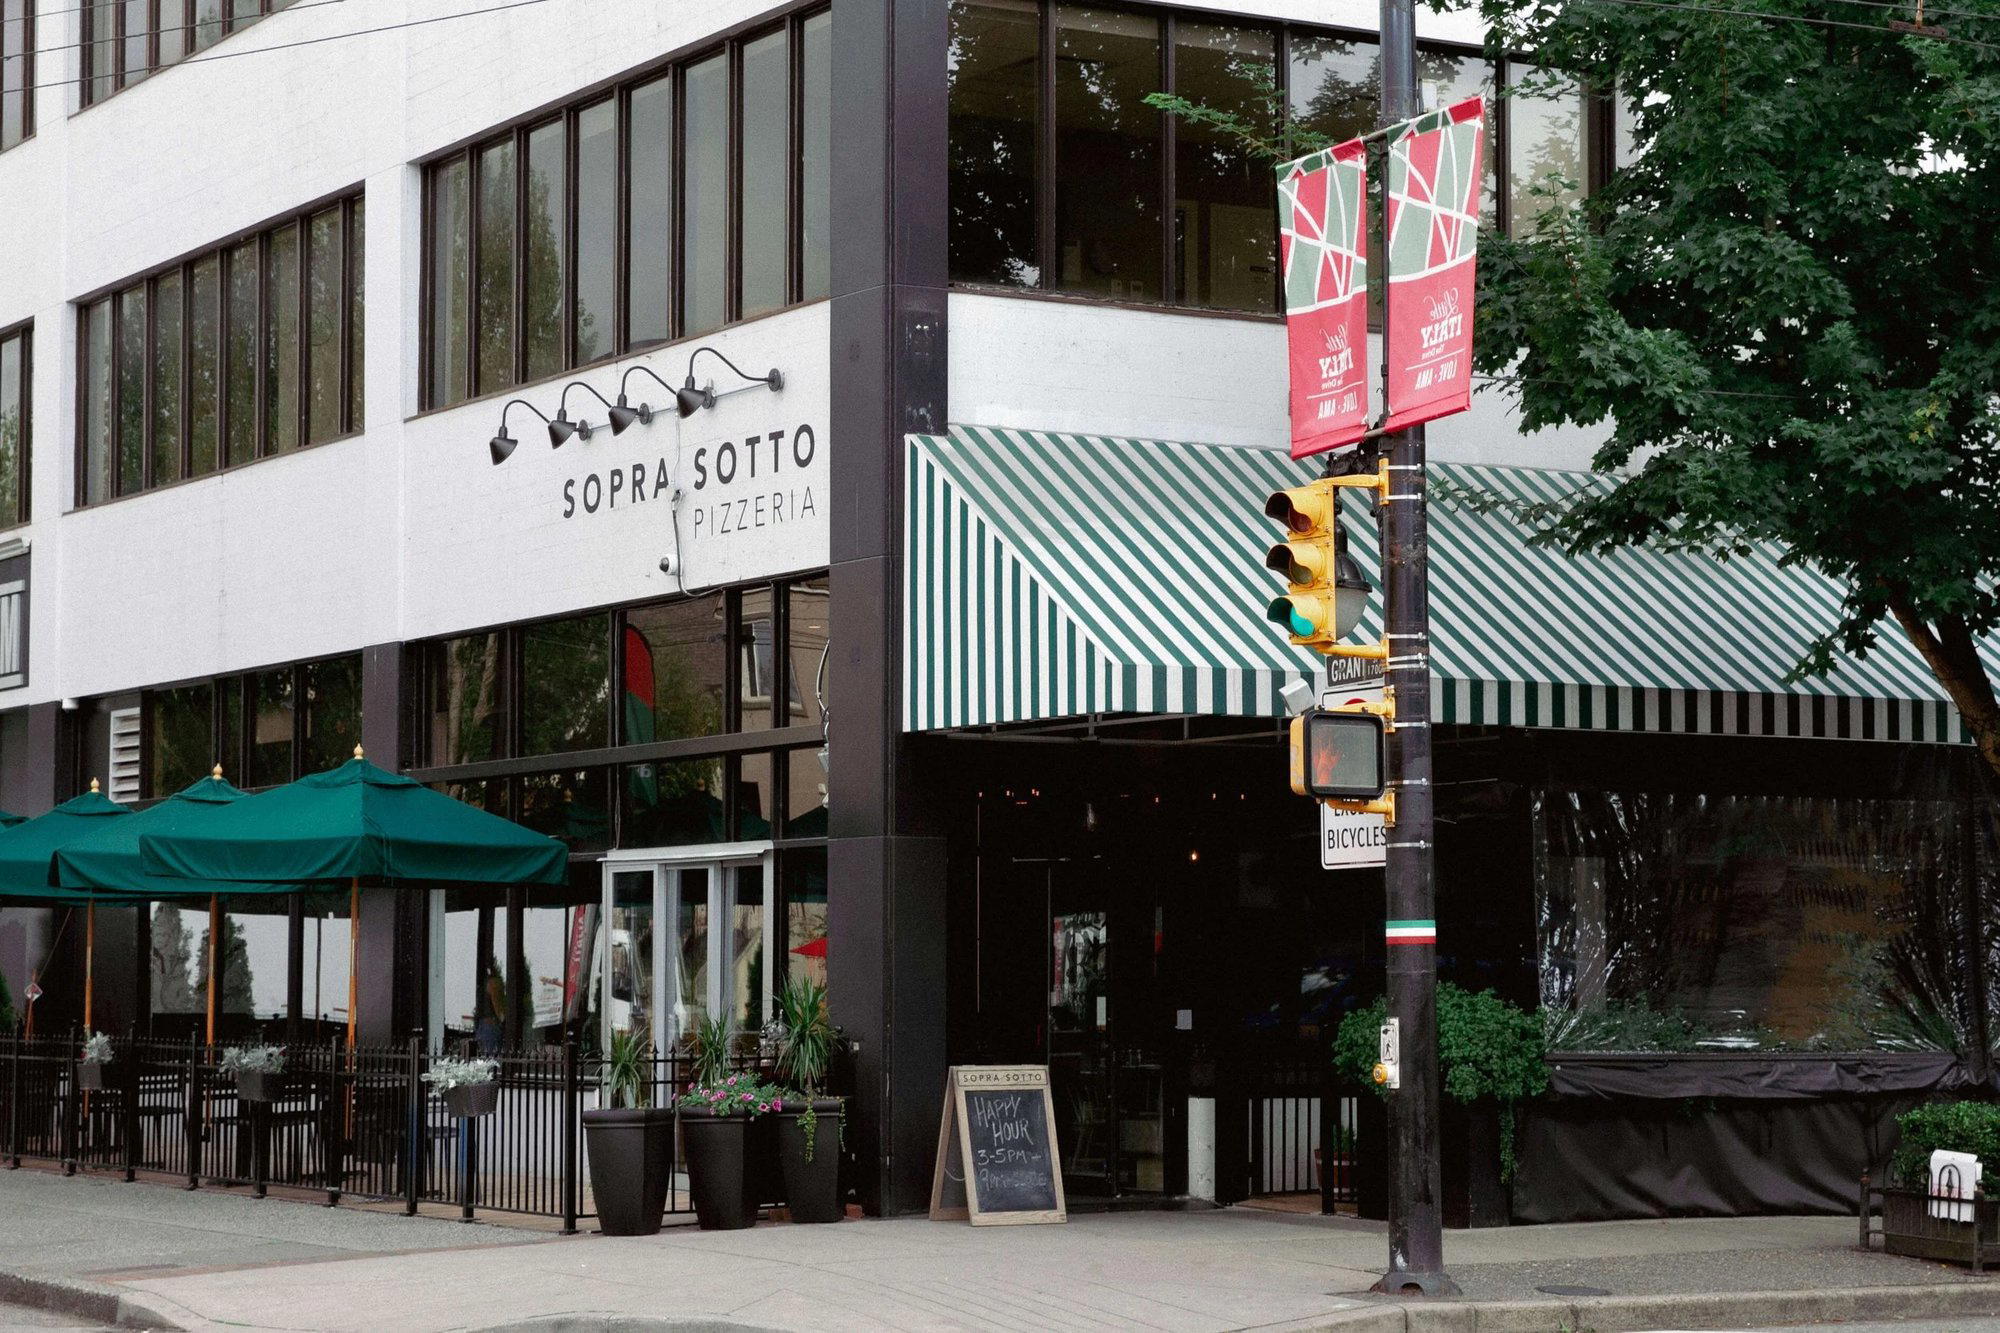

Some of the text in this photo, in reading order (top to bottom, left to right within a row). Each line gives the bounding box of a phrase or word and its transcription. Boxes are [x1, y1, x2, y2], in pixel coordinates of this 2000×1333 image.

[563, 424, 815, 518] SOPRA SOTTO
[694, 486, 816, 539] PIZZERIA
[1327, 826, 1387, 849] BICYCLES
[963, 1073, 1042, 1083] SOPRA SOTTO
[974, 1094, 1021, 1128] HAPPY
[992, 1118, 1034, 1147] HOUR
[977, 1148, 1028, 1166] 3-5PM
